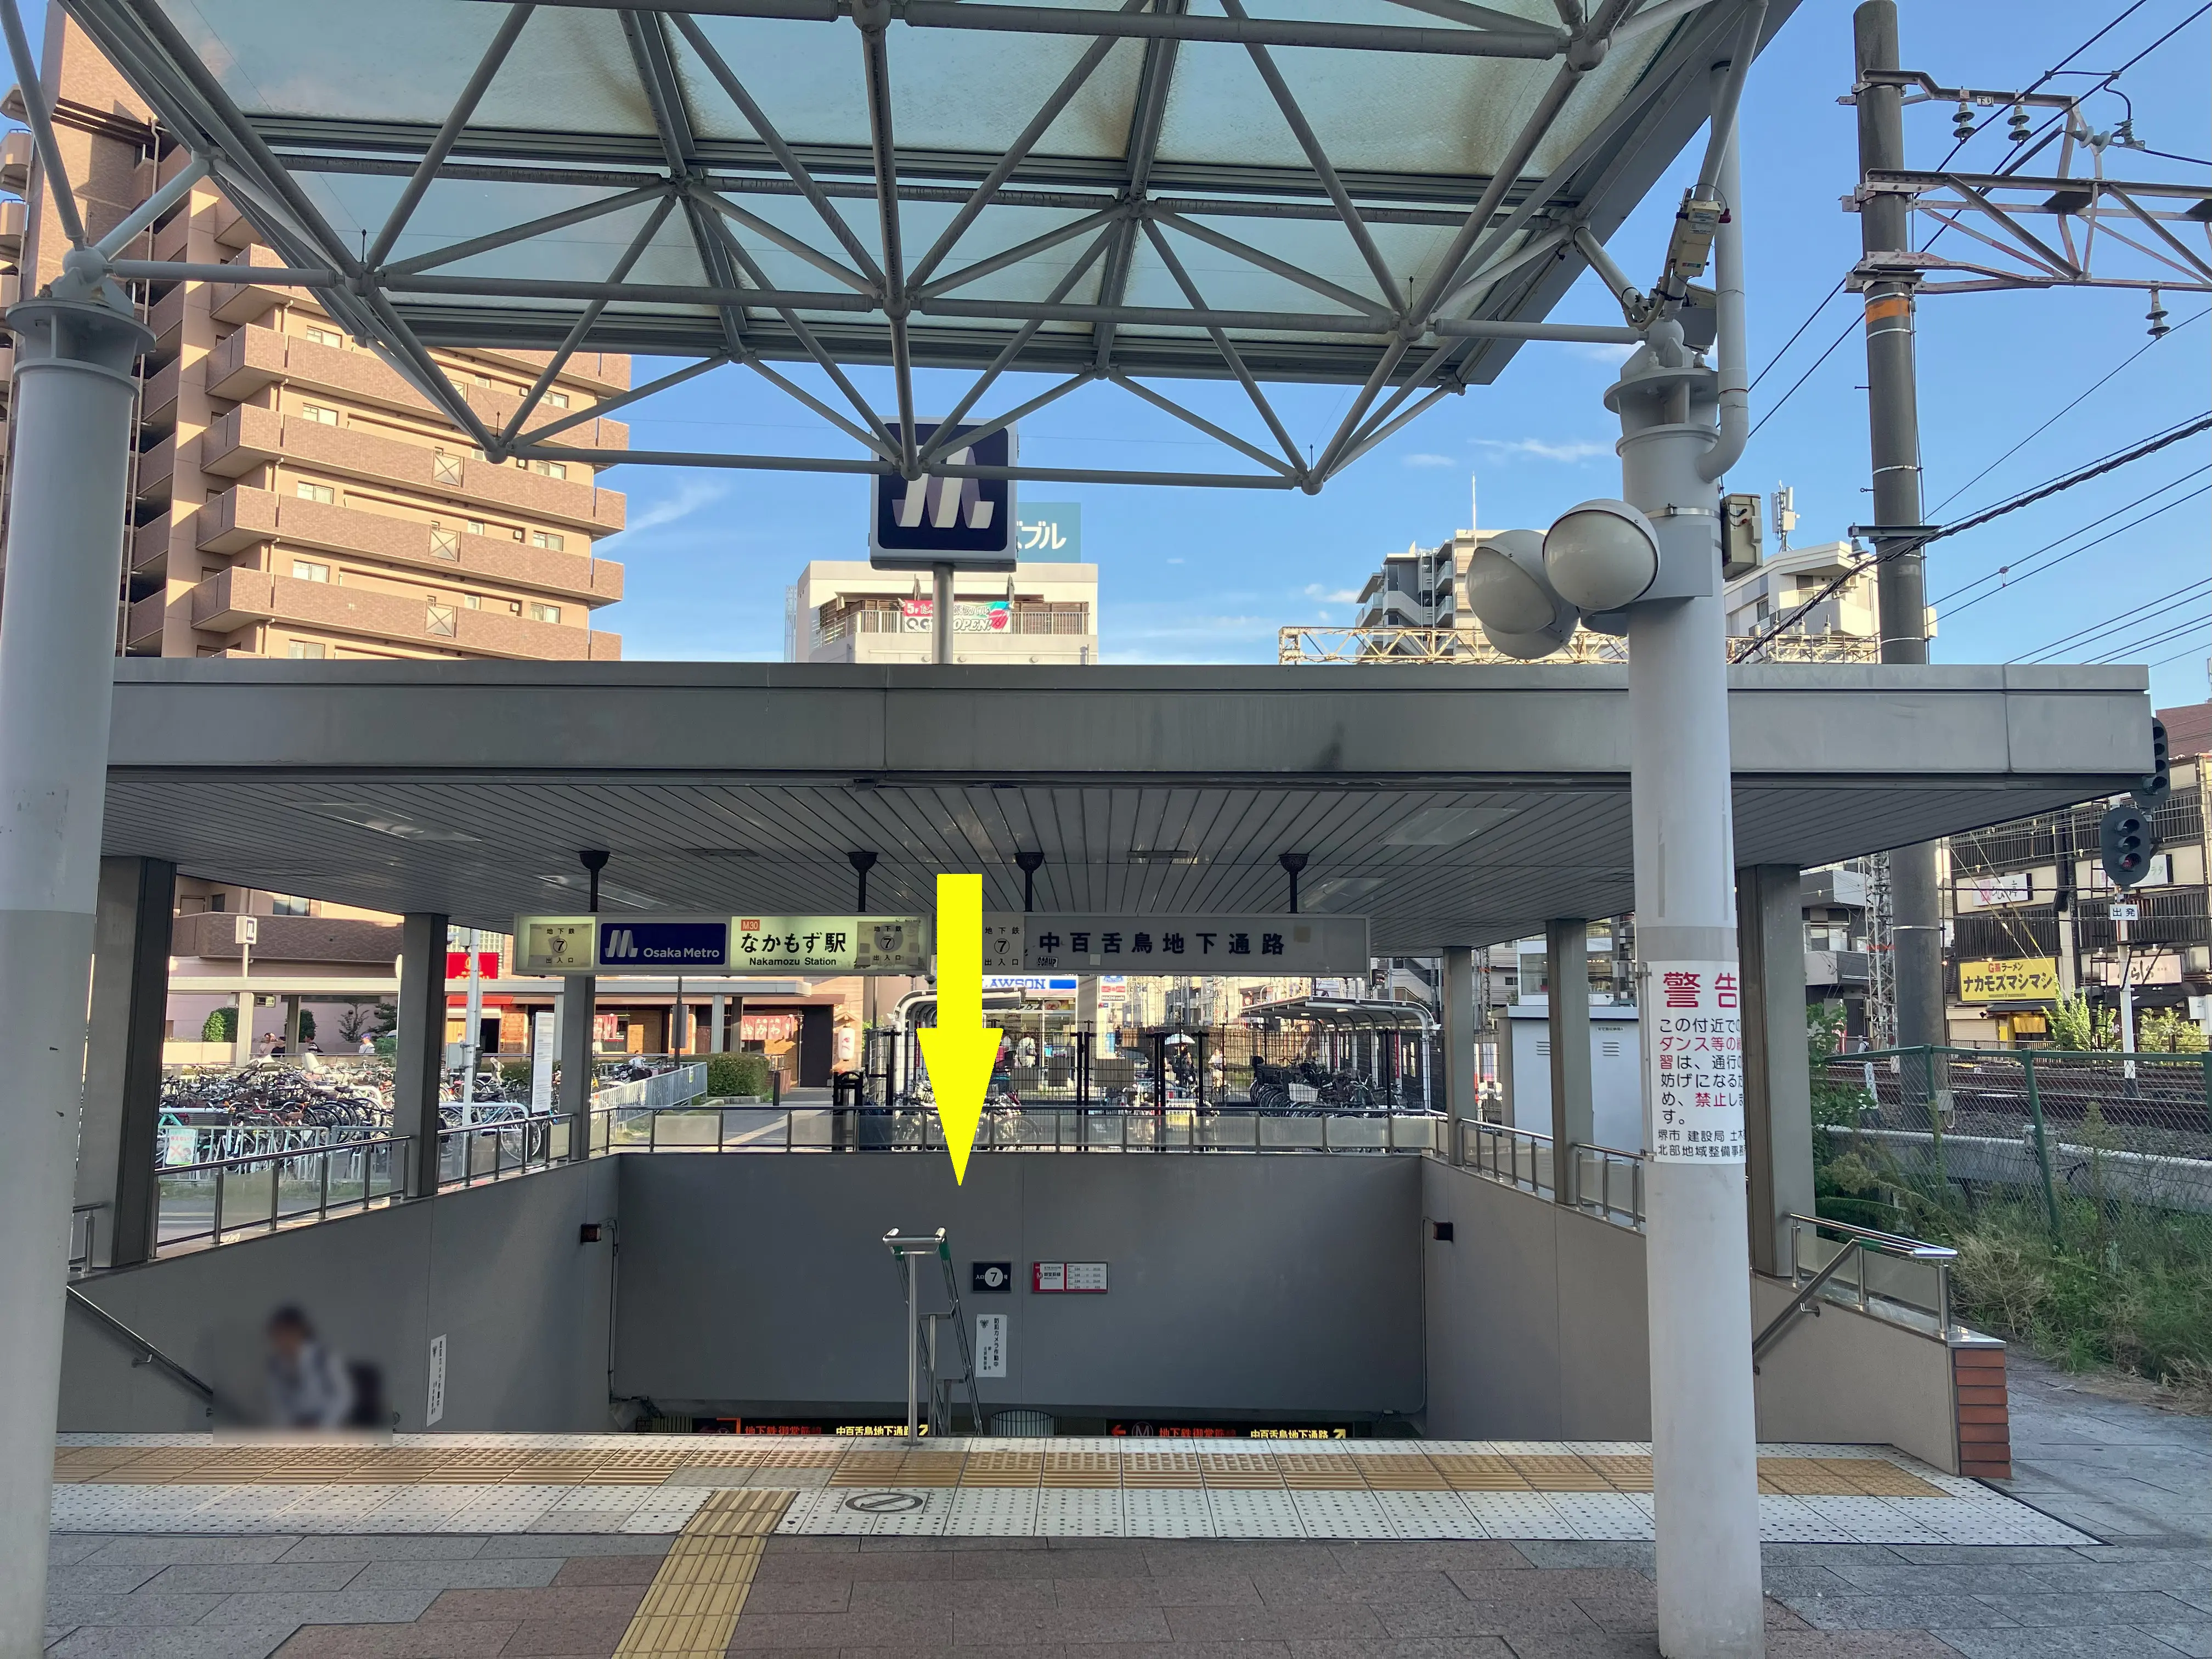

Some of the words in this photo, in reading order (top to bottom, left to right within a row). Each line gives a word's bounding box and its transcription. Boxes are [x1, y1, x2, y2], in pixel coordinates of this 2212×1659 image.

[1977, 97, 1993, 105] 下り
[2113, 908, 2135, 917] 出発
[742, 921, 759, 930] M30
[985, 926, 1019, 935] 地下鉄
[741, 932, 846, 953] なかもず駅
[1039, 932, 1285, 956] 中百舌鳥地下通路
[643, 947, 681, 958] Osaka
[684, 947, 720, 958] Metro
[749, 957, 800, 966] Nakamozu
[804, 957, 836, 966] Station
[984, 958, 1019, 966] 出入口
[1963, 972, 2053, 992] ナカモズマシマシ
[1663, 972, 1737, 1008] 警告
[1662, 1110, 1685, 1125] す。
[1657, 1129, 1680, 1141] 堺市
[1688, 1130, 1725, 1143] 建設局
